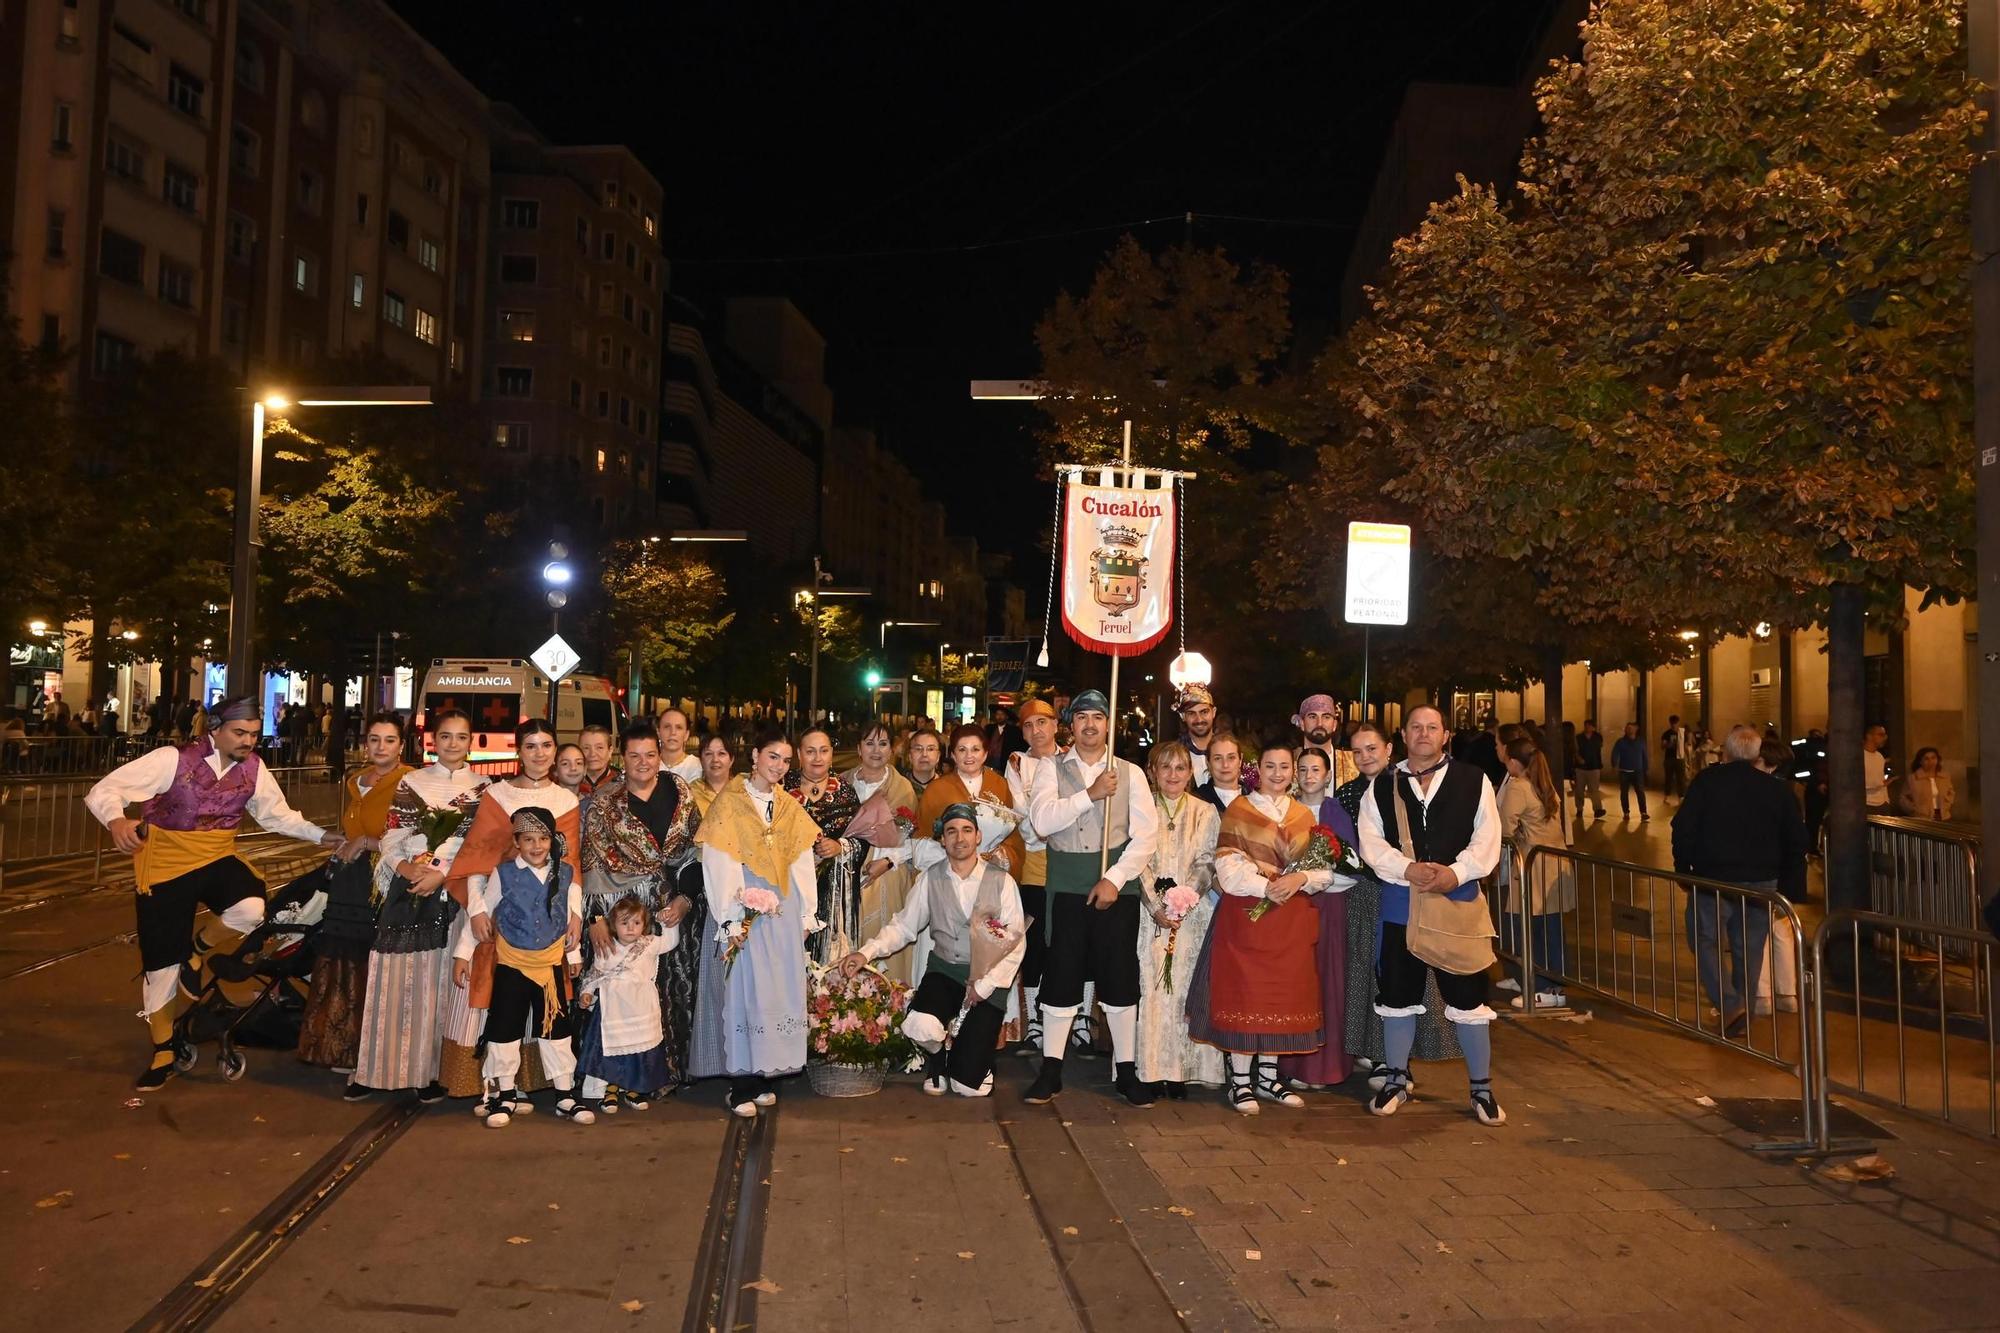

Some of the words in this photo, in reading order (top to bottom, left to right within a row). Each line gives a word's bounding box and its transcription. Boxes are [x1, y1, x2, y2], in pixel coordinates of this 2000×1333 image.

[1081, 496, 1163, 518] Cucalón
[1099, 620, 1132, 636] Teruel
[437, 675, 512, 686] AMBULANCIA
